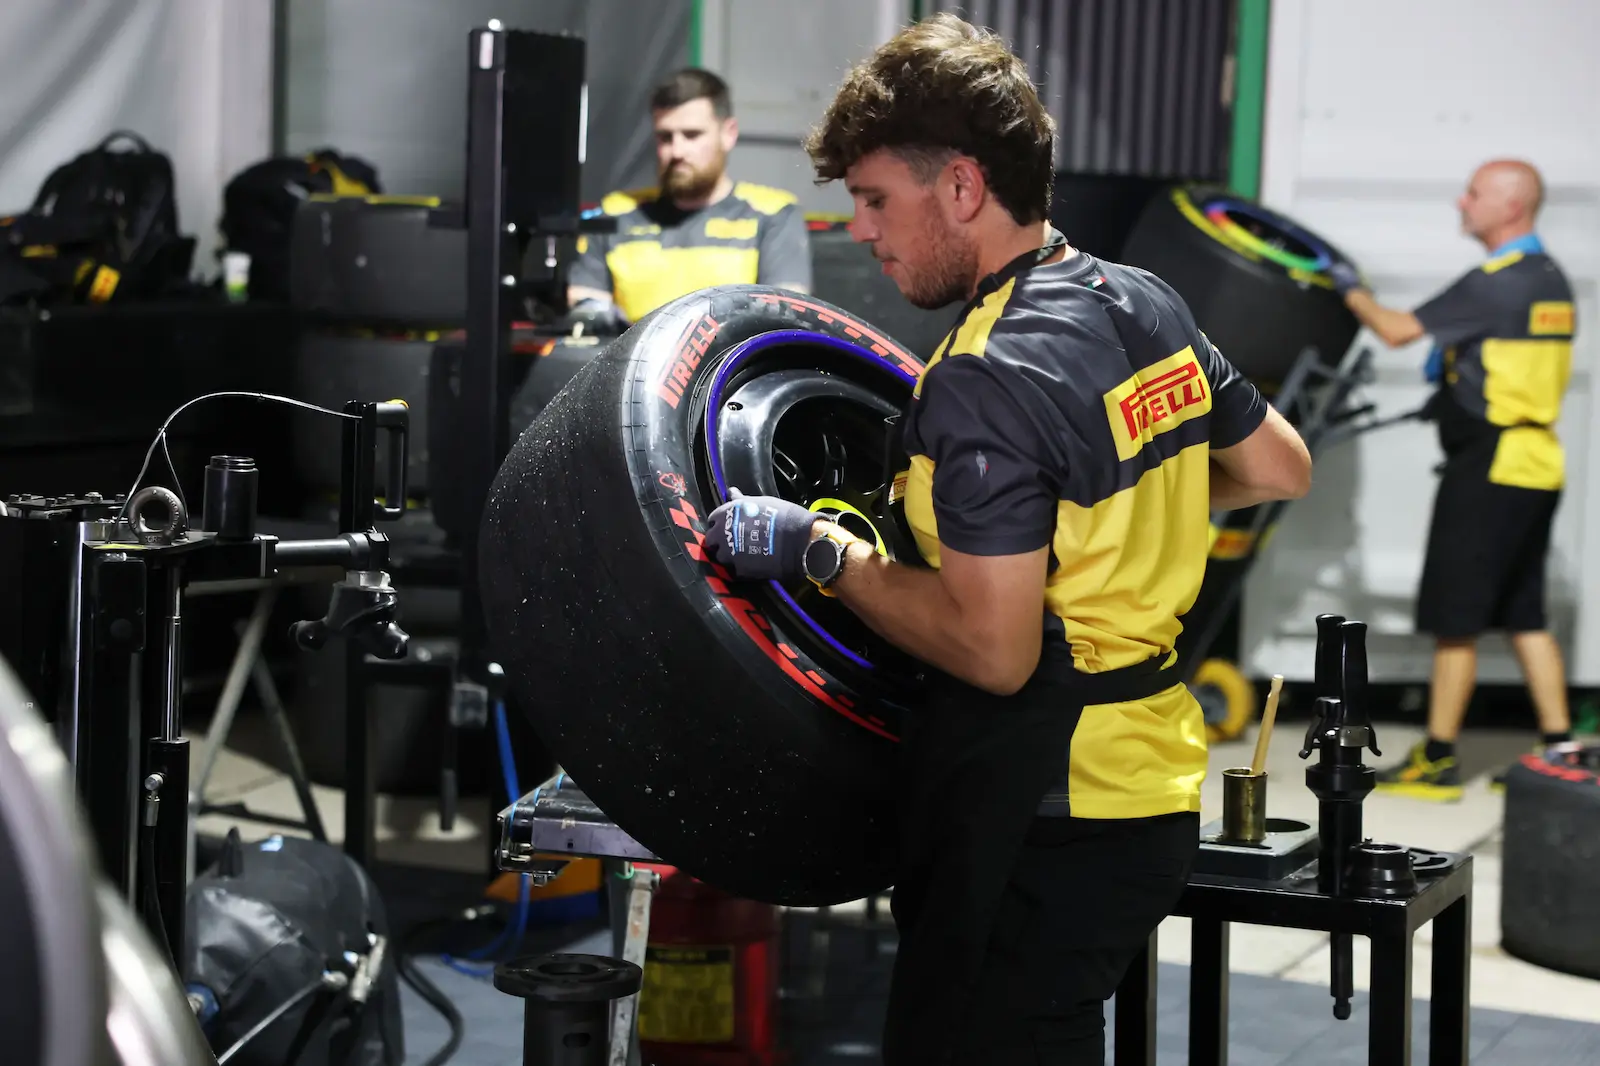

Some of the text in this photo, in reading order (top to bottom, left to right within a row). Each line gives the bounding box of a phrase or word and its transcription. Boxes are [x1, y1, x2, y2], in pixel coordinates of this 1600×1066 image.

[656, 314, 721, 410] PIRELLI
[1119, 361, 1206, 441] PIRELLI
[724, 505, 736, 556] uvex
